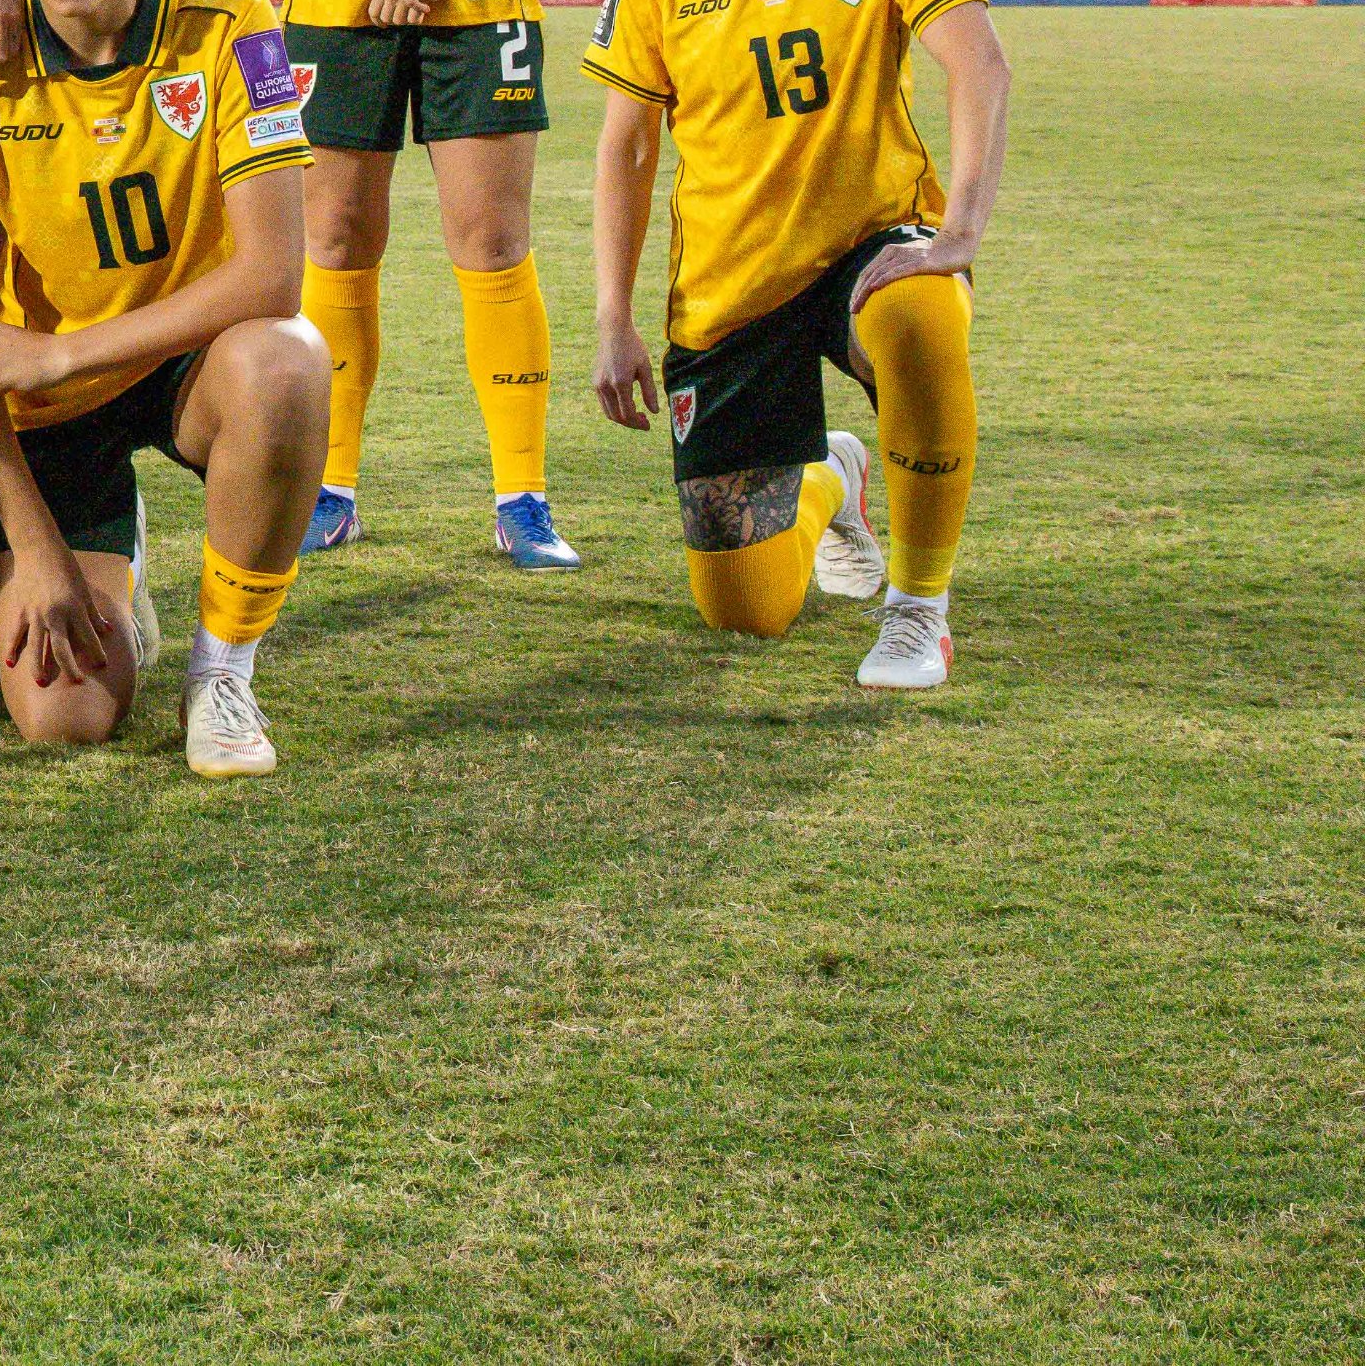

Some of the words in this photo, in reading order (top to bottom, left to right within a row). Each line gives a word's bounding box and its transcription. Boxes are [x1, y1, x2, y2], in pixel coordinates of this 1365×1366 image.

[496, 20, 531, 82] 2
[491, 87, 536, 101] SUDU
[748, 27, 831, 121] 13
[78, 170, 173, 271] 10
[492, 368, 549, 385] SUDU
[888, 449, 961, 476] SUDU
